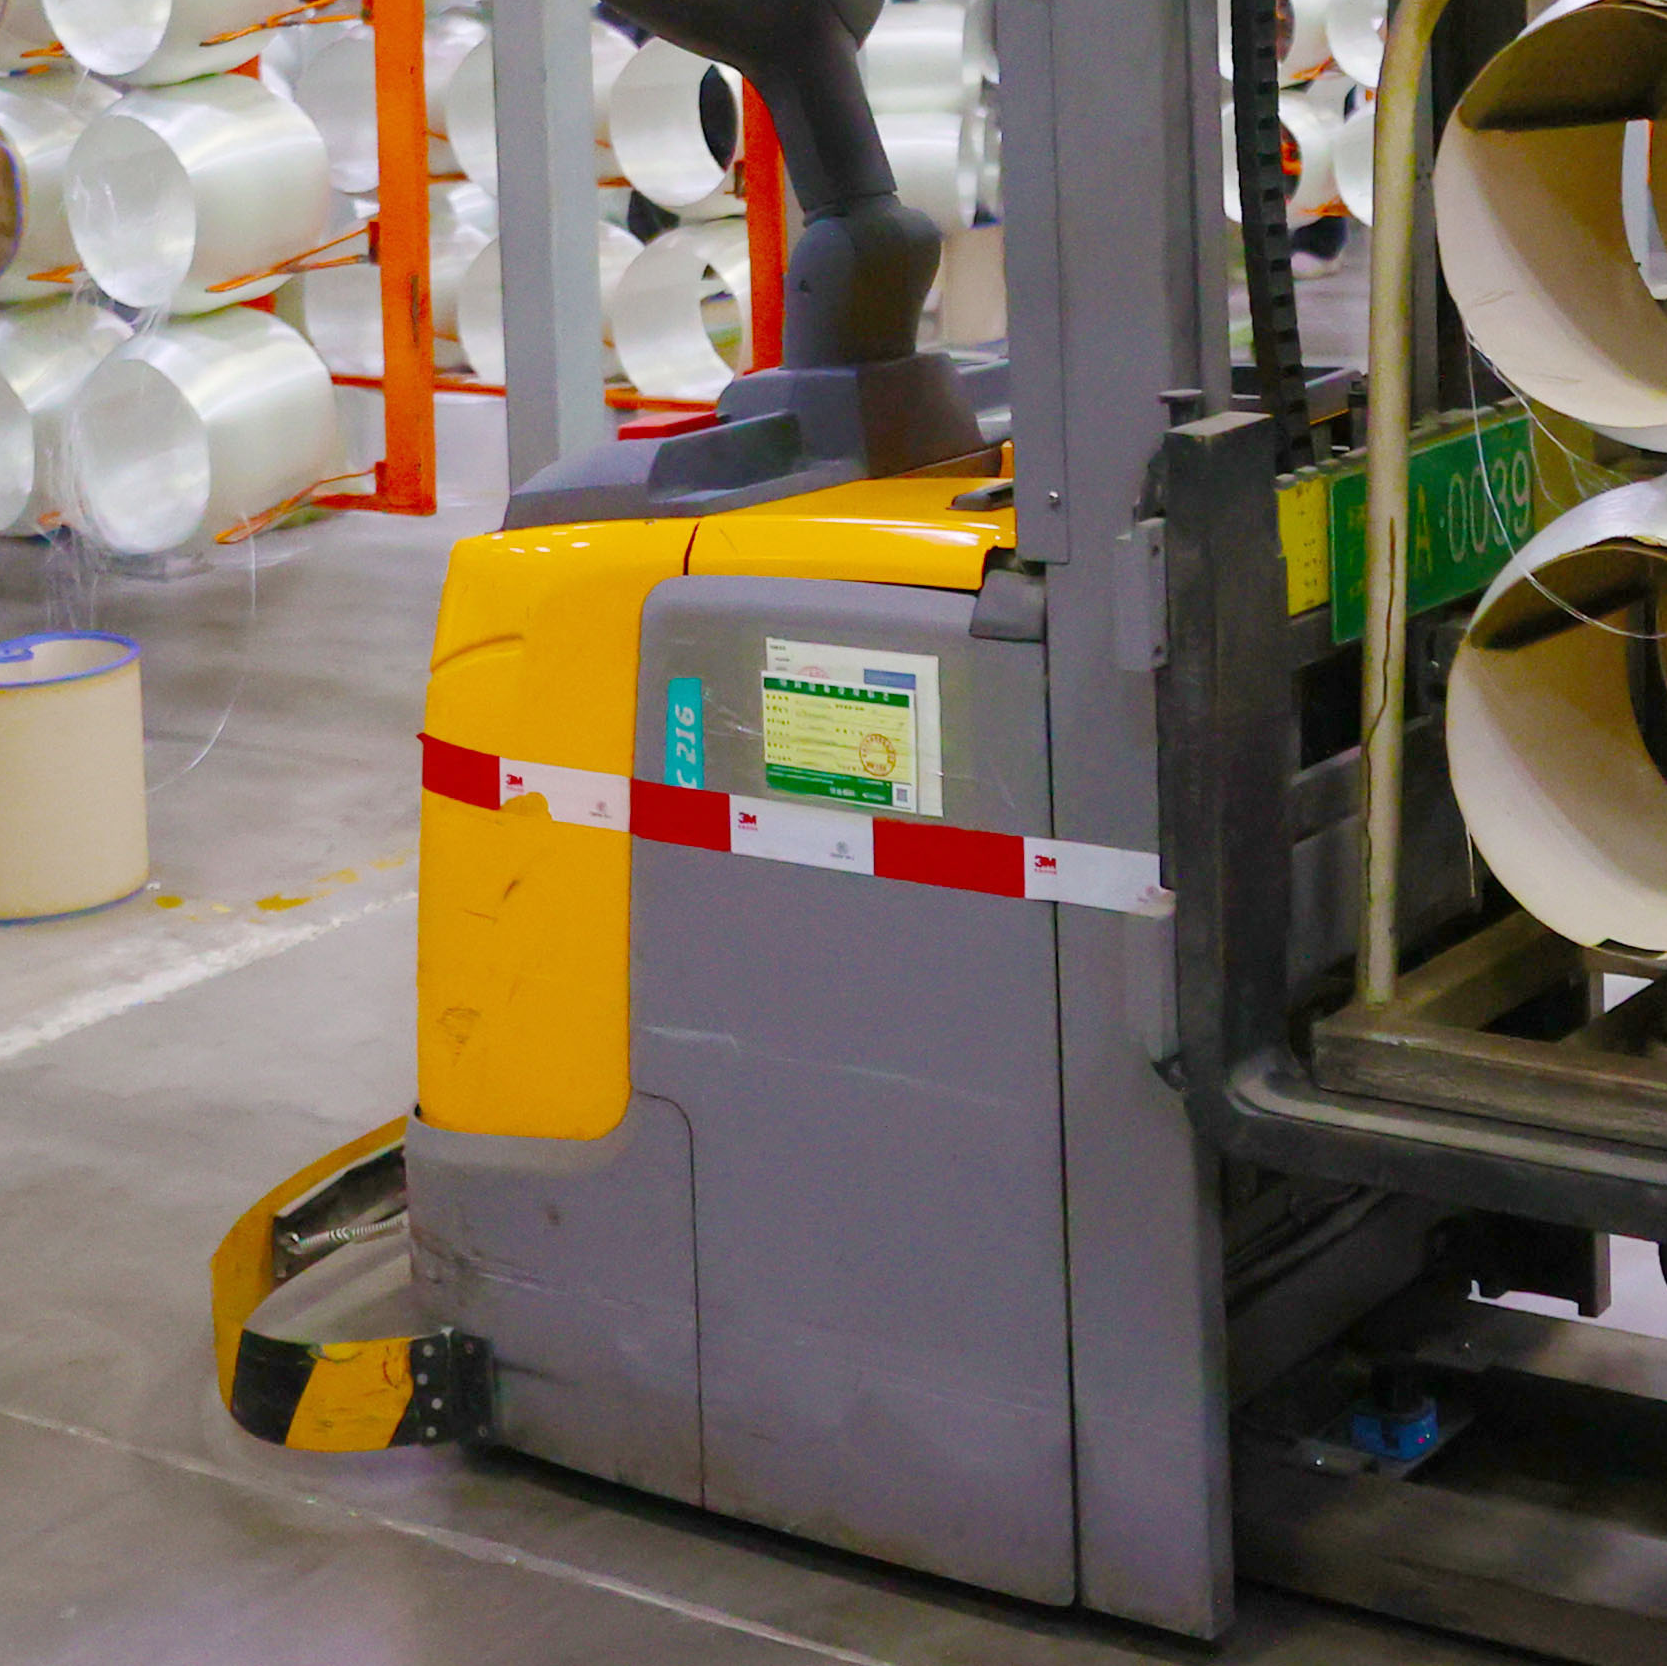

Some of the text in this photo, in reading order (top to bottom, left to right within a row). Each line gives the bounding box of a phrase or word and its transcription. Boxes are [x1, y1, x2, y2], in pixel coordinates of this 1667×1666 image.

[1447, 450, 1531, 563] 0039
[675, 703, 696, 765] 216
[506, 773, 524, 787] 3M
[738, 811, 757, 825] 3M
[1034, 854, 1057, 869] 3M
